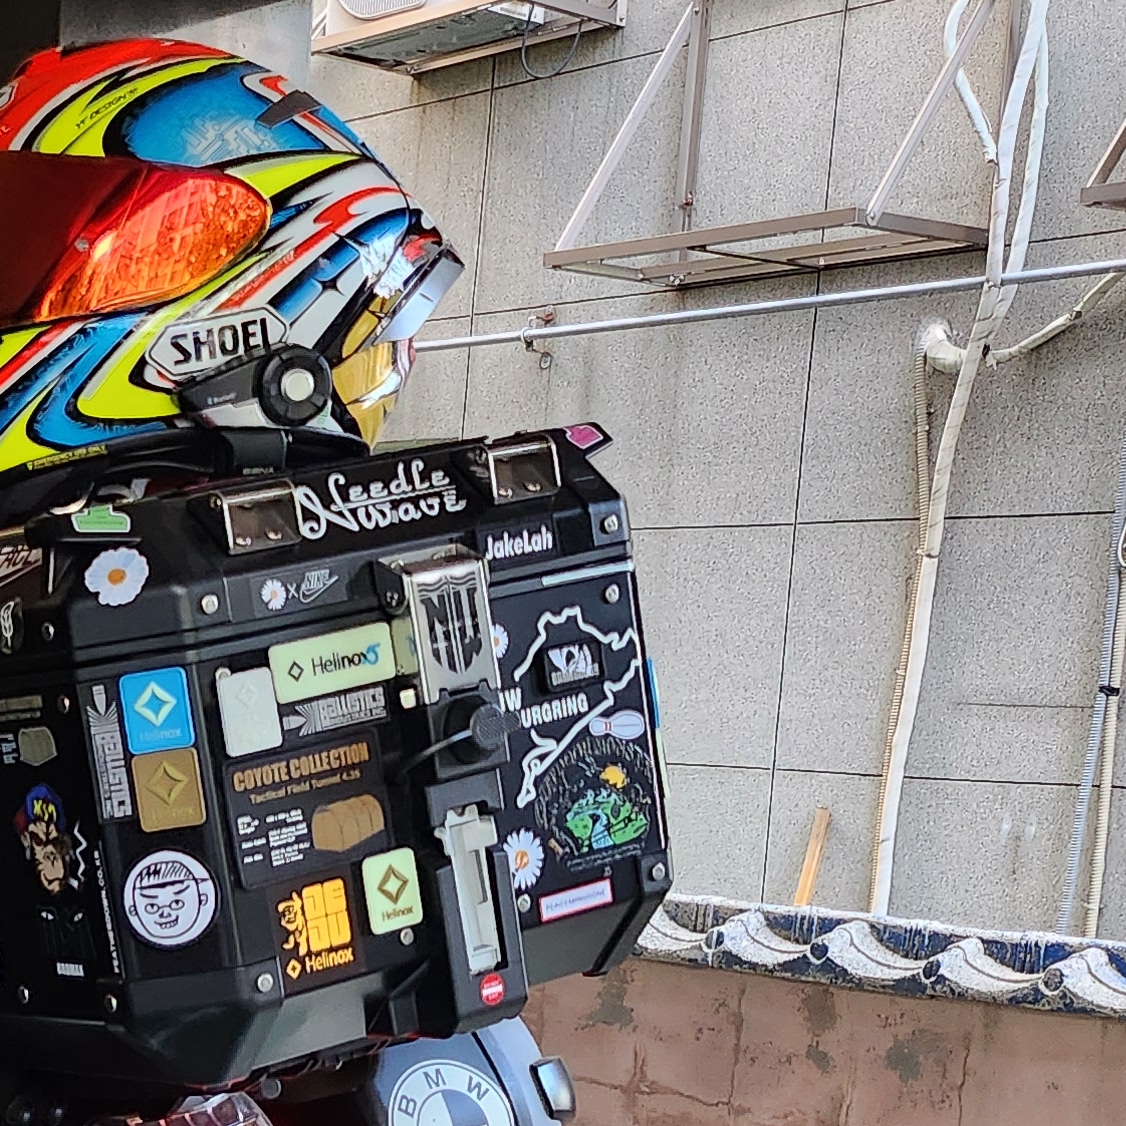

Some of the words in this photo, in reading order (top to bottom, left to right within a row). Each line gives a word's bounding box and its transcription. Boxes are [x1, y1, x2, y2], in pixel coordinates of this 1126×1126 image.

[170, 317, 271, 367] SHOEI
[485, 523, 553, 561] JakeLah
[304, 569, 330, 590] NIKE
[233, 761, 290, 793] COYOTE
[289, 741, 370, 779] COLLECTION
[382, 905, 414, 923] Helinox
[305, 947, 354, 974] Helinox
[397, 1067, 491, 1119] BMW
